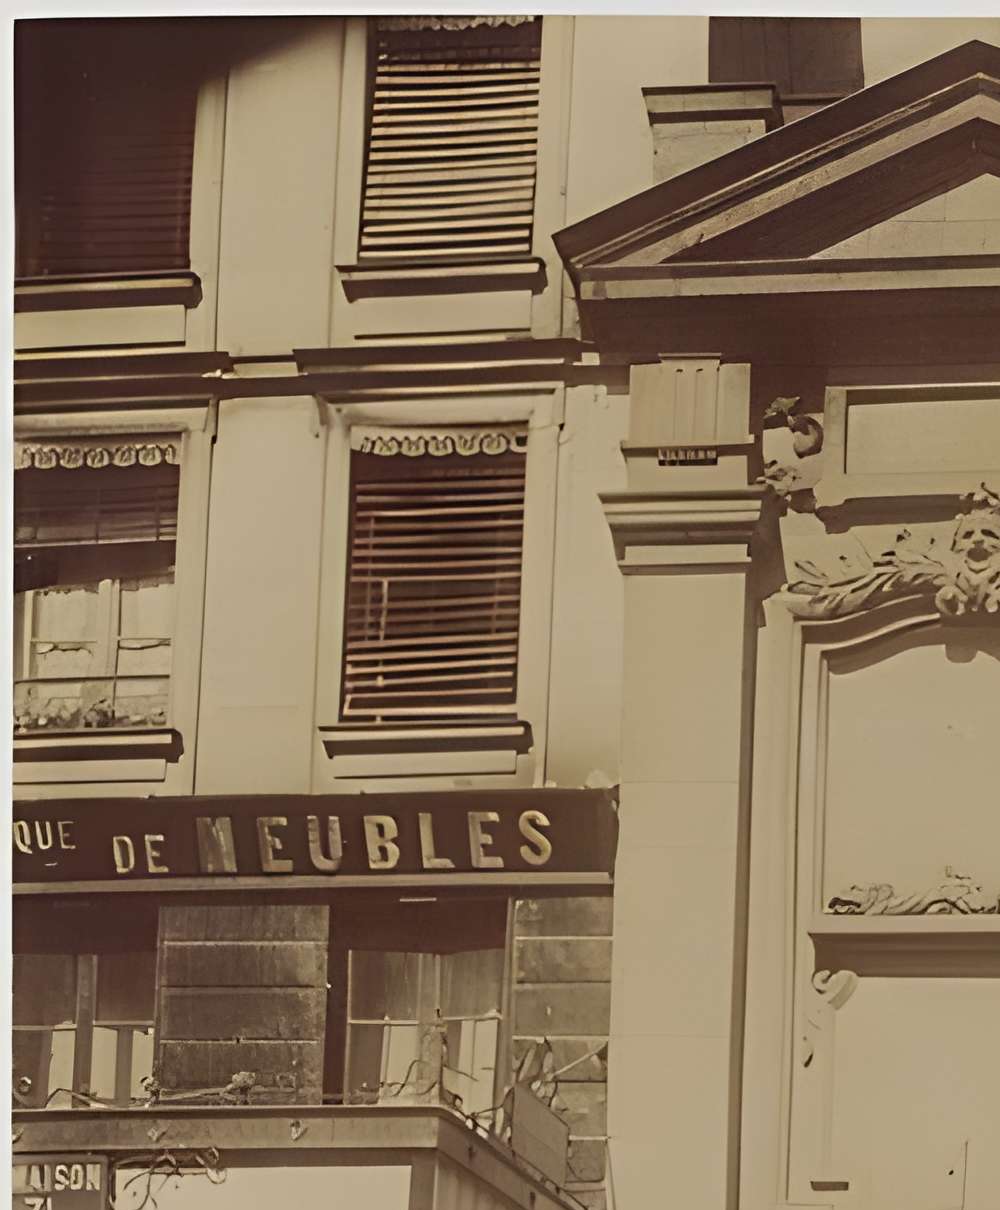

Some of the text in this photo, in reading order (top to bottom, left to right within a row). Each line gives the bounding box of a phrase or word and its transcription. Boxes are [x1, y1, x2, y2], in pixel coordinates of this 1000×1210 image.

[13, 809, 553, 874] QUE DE MEUBLES
